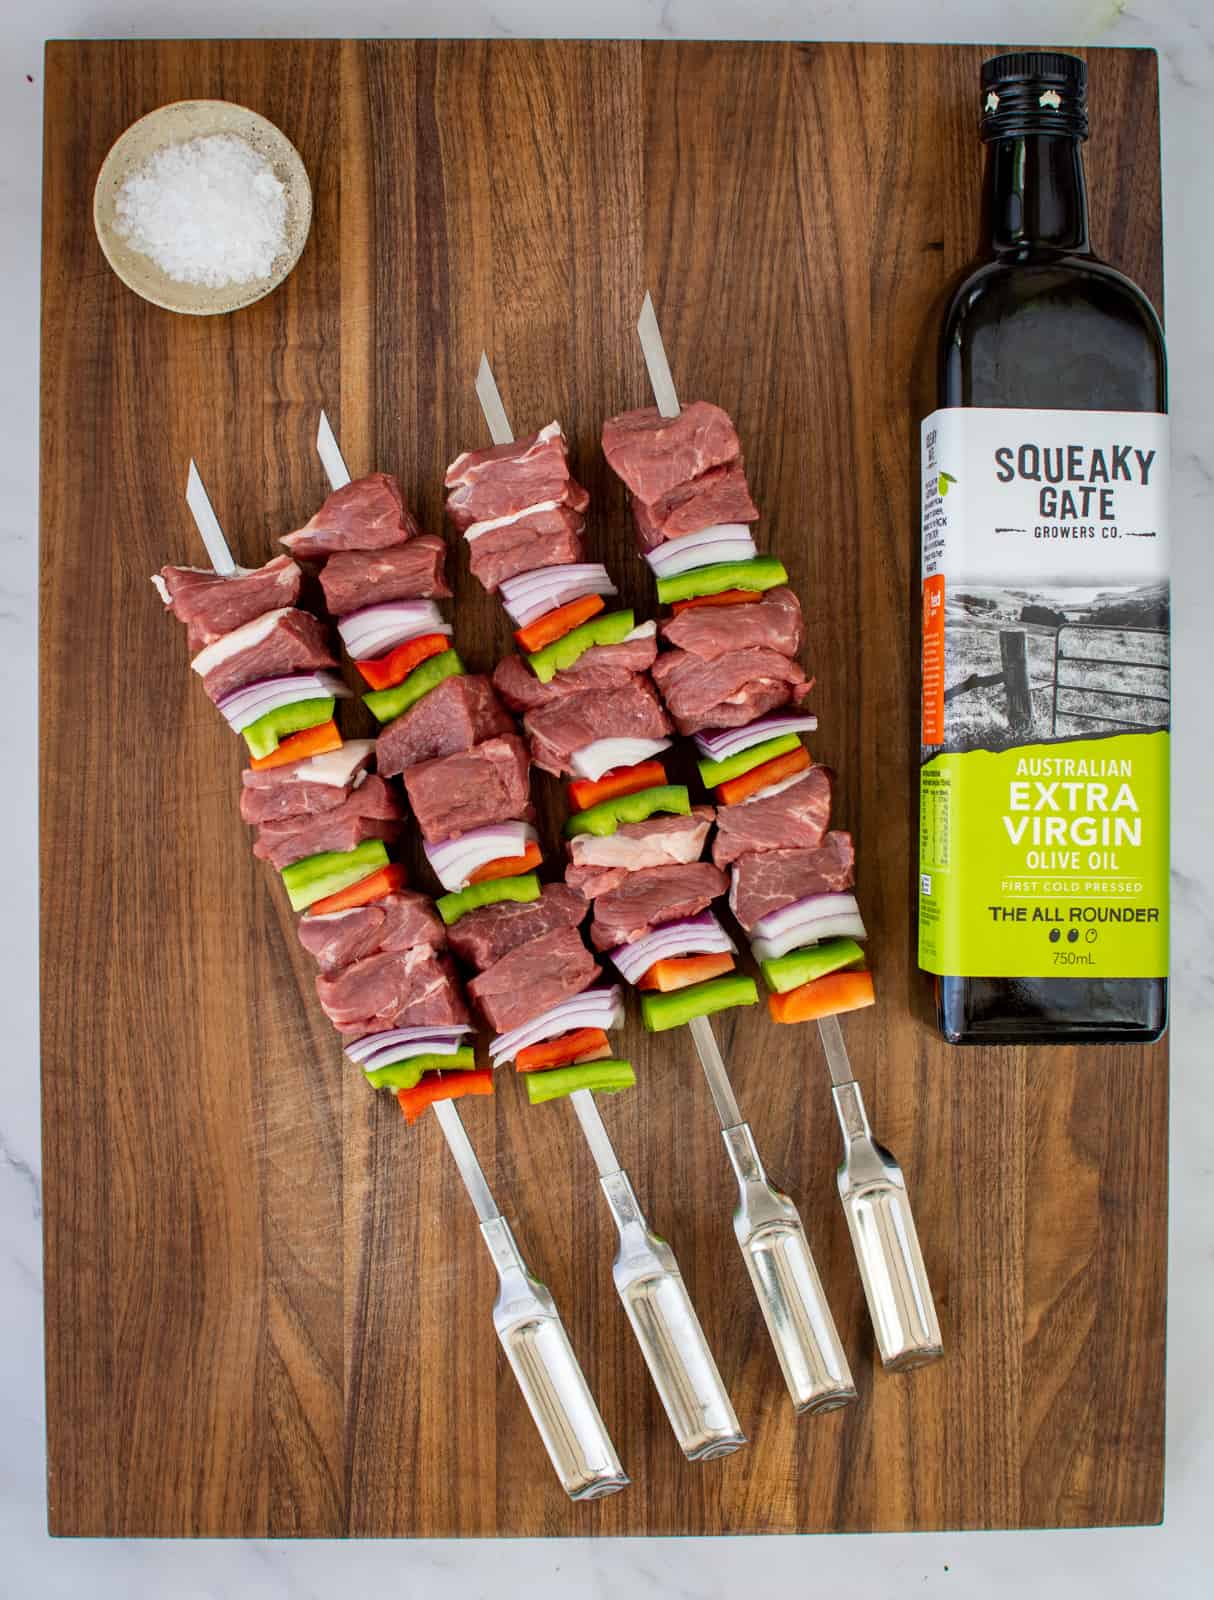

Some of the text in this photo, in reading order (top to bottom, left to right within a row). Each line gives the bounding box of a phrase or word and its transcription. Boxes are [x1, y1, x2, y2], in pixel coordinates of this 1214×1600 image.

[994, 443, 1157, 485] SQUEAKY
[1039, 485, 1116, 520] GATE
[1034, 526, 1123, 539] GROWERS CO.
[1015, 758, 1133, 777] AUSTRALIAN
[1009, 781, 1139, 812] EXTRA
[1002, 815, 1142, 847] VIRGIN
[1026, 851, 1119, 870] OLIVE OIL
[1001, 881, 1144, 893] FIRST COLD PRESSED
[988, 906, 1159, 923] THE ALL ROUNDER
[1052, 952, 1096, 965] 750mL
